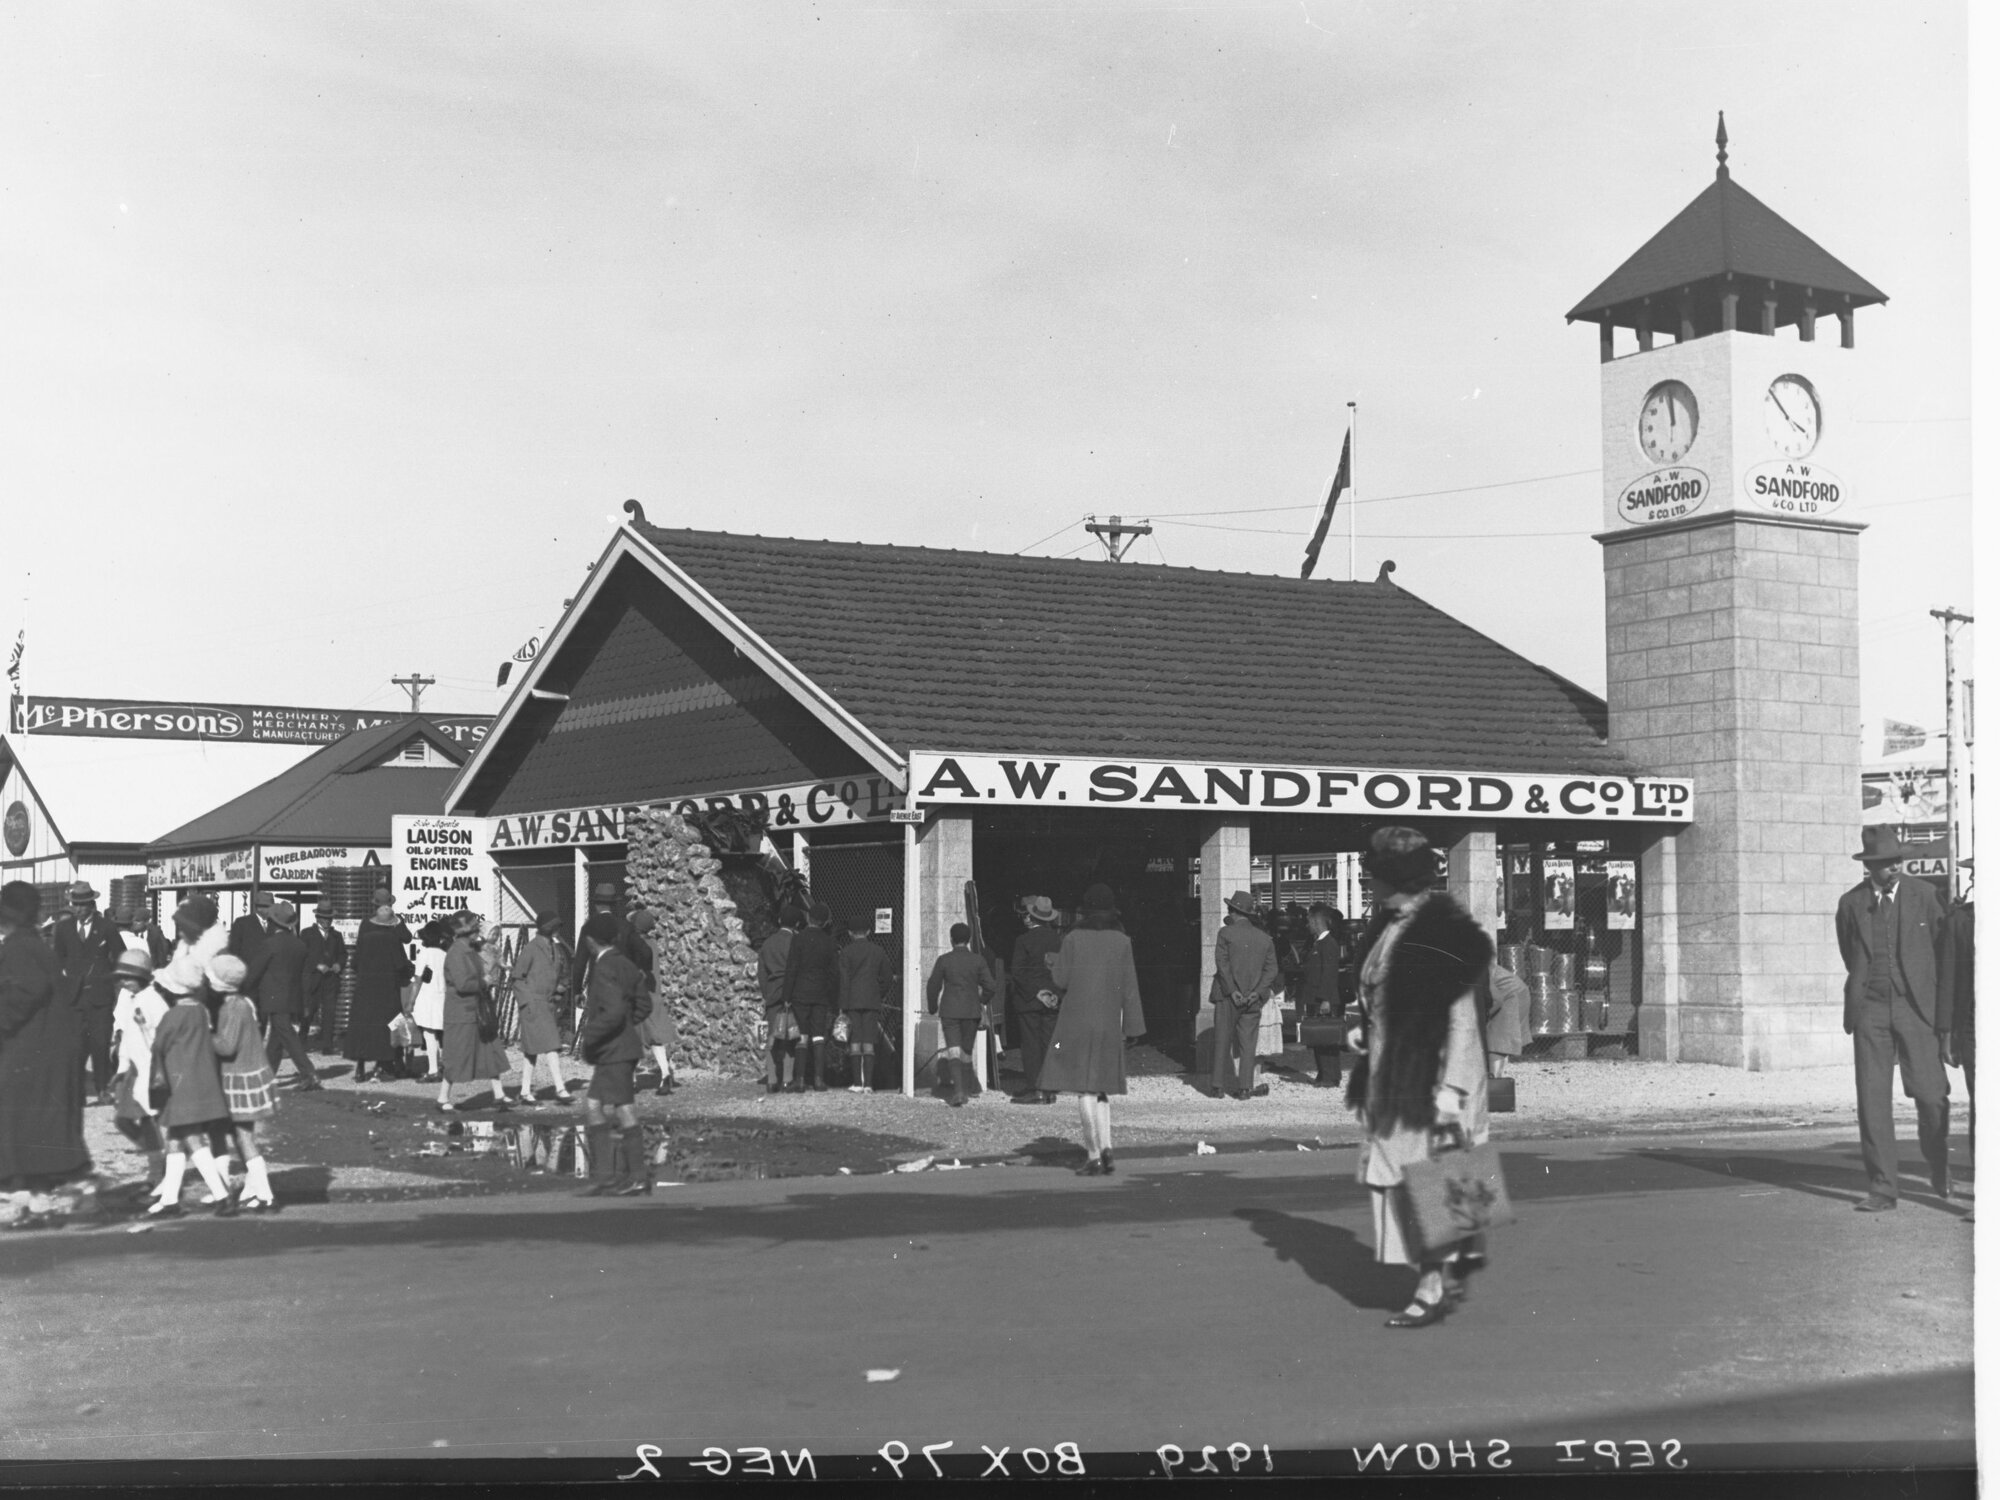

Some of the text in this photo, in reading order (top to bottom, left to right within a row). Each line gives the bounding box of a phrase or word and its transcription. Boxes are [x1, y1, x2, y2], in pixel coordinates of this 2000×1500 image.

[1626, 479, 1702, 511] SANDFORD
[1754, 474, 1840, 503] SANDFORD
[252, 710, 342, 722] MACHINERY
[252, 719, 346, 732] MERCHANTS
[262, 729, 342, 742] MANUFACTURER
[1088, 763, 1514, 813] SANDFORD
[1524, 783, 1550, 814] &
[775, 793, 800, 827] &
[407, 828, 472, 845] LAUSON
[264, 848, 348, 867] WHEELBARROWS
[406, 846, 424, 855] OIL
[433, 846, 474, 856] PETROL
[410, 857, 468, 871] ENGINES
[269, 867, 314, 881] GARDEN
[403, 876, 482, 892] ALFA-LAVAL
[407, 891, 469, 910] and FELIX
